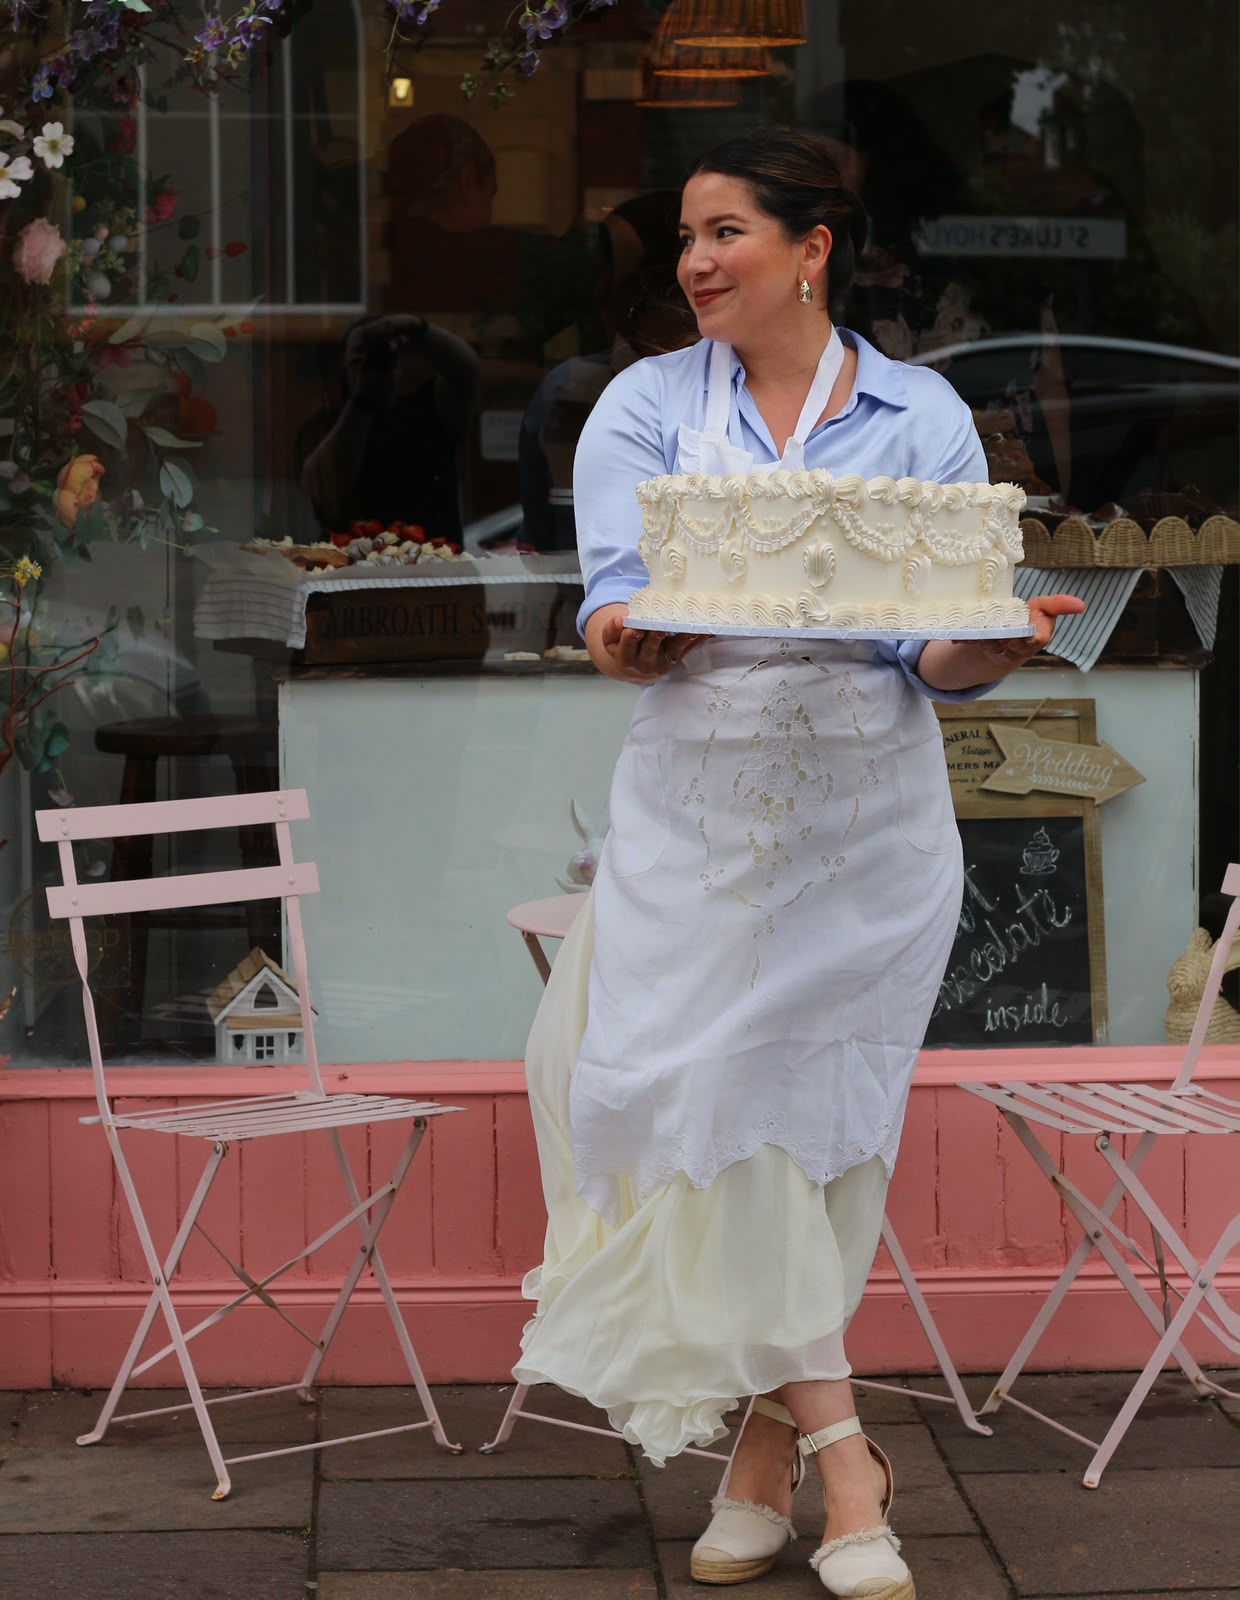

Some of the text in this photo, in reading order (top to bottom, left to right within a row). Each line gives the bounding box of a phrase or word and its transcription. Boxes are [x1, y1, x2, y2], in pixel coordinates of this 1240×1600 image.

[321, 603, 459, 638] ARBROATH
[943, 729, 981, 748] ENERAL
[946, 762, 979, 770] MERS
[1015, 743, 1113, 791] Wedding
[956, 864, 1000, 937] ot
[931, 883, 1073, 1018] hocolate
[984, 982, 1068, 1032] inside
